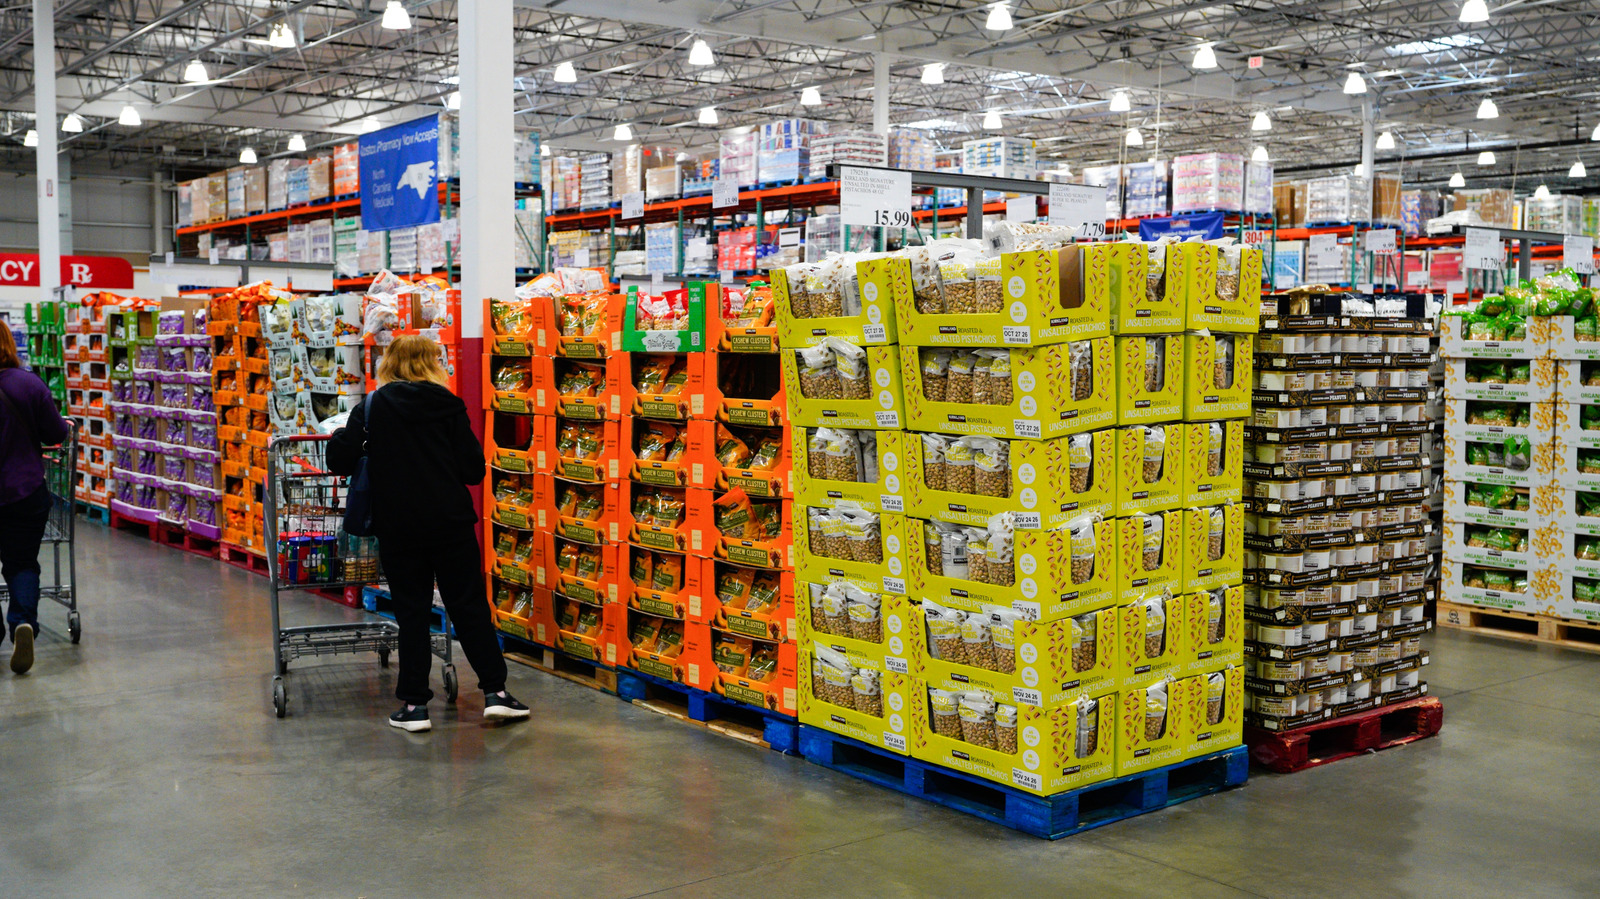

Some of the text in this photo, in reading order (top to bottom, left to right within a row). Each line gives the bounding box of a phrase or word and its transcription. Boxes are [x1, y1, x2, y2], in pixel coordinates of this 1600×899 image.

[377, 137, 401, 152] Pharmacy
[402, 134, 414, 145] Now
[415, 128, 438, 143] Accepts
[372, 168, 385, 180] North
[373, 182, 392, 195] Carolina
[373, 196, 394, 208] Medicaid
[725, 197, 737, 205] 13.99
[874, 209, 909, 227] 15.99
[1083, 222, 1105, 237] 7.79
[1245, 232, 1263, 244] 304
[1480, 257, 1498, 268] 17.79
[1576, 262, 1592, 272] 17.99
[0, 260, 34, 281] CY
[1125, 318, 1181, 327] UNSALTED PISTACHIOS
[1192, 314, 1255, 326] UNSALTED PISTACHIOS
[1038, 322, 1106, 338] UNSALTED PISTACHIOS
[930, 335, 997, 343] UNSALTED PISTACHIOS
[1124, 406, 1180, 418] UNSALTED PISTACHIOS
[1193, 402, 1248, 412] UNSALTED PISTACHIOS
[1049, 411, 1113, 431] UNSALTED PISTACHIOS
[938, 422, 1006, 435] UNSALTED PISTACHIOS
[657, 470, 674, 478] CLUSTERS
[1188, 488, 1239, 502] UNSALTED PISTACHIOS
[1121, 495, 1179, 510] UNSALTED PISTACHIOS
[938, 511, 969, 521] UNSALTED
[1504, 515, 1528, 523] CASHEWS
[729, 546, 766, 558] CASHEW CLUSTERS
[302, 553, 326, 568] Jif
[1188, 571, 1240, 588] UNSALTED PISTACHIOS
[1502, 598, 1526, 606] CASHEWS
[728, 617, 765, 630] CASHEW CLUSTERS
[822, 720, 878, 742] UNSALTED PISTACHIOS
[1123, 748, 1182, 769] UNSALTED PISTACHIOS
[942, 755, 1008, 780] UNSALTED PISTACHIOS
[1013, 772, 1023, 780] NOV
